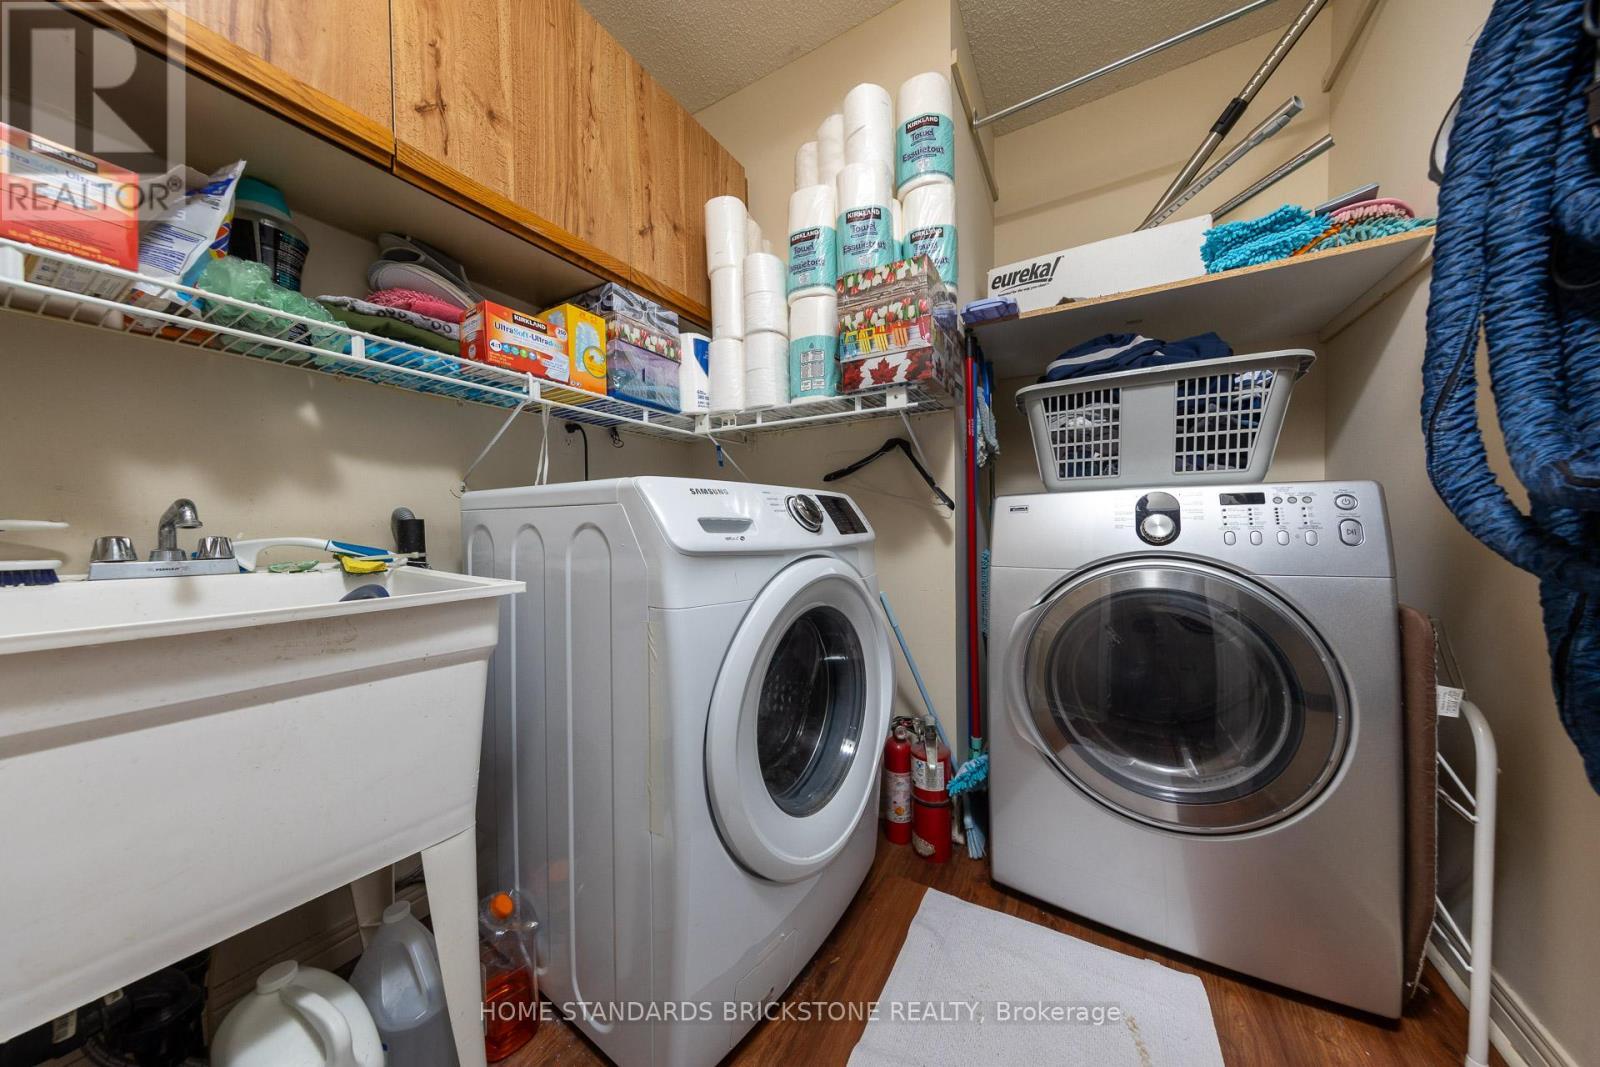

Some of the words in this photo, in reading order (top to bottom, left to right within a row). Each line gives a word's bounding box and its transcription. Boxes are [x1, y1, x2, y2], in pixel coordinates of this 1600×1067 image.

[906, 116, 939, 130] KIRKLAND
[846, 208, 881, 220] KIRKLAND
[991, 256, 1062, 290] eureka!
[513, 313, 547, 331] KIRKLAND
[689, 488, 729, 496] SAMSUNG
